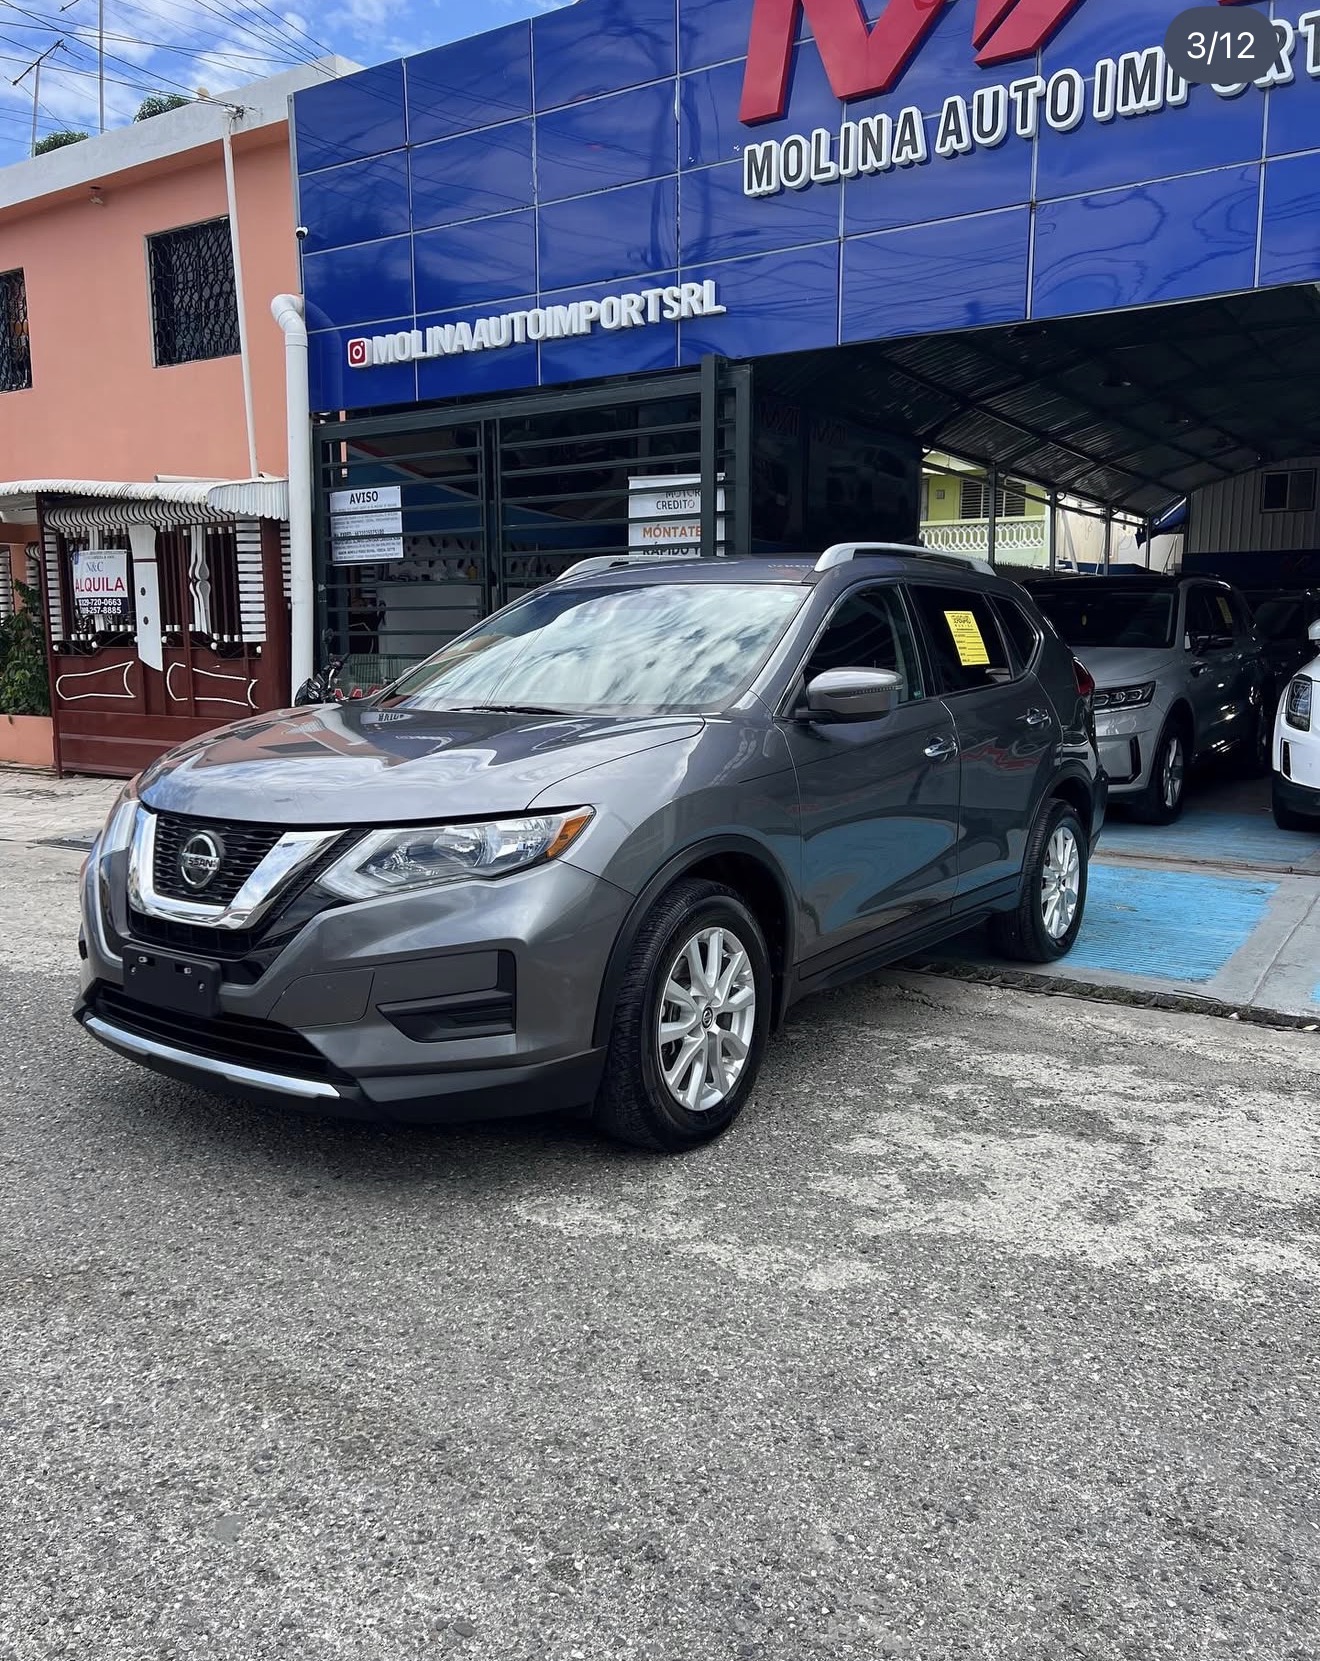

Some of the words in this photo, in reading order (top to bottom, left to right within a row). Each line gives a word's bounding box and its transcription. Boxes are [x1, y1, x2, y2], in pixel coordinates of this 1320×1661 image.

[743, 106, 928, 197] MOLINA
[936, 68, 1084, 157] AUTO
[372, 279, 727, 365] MOLINAAUTOIMPORTSRL
[349, 491, 379, 505] AVISO
[75, 576, 125, 593] ALQUILA
